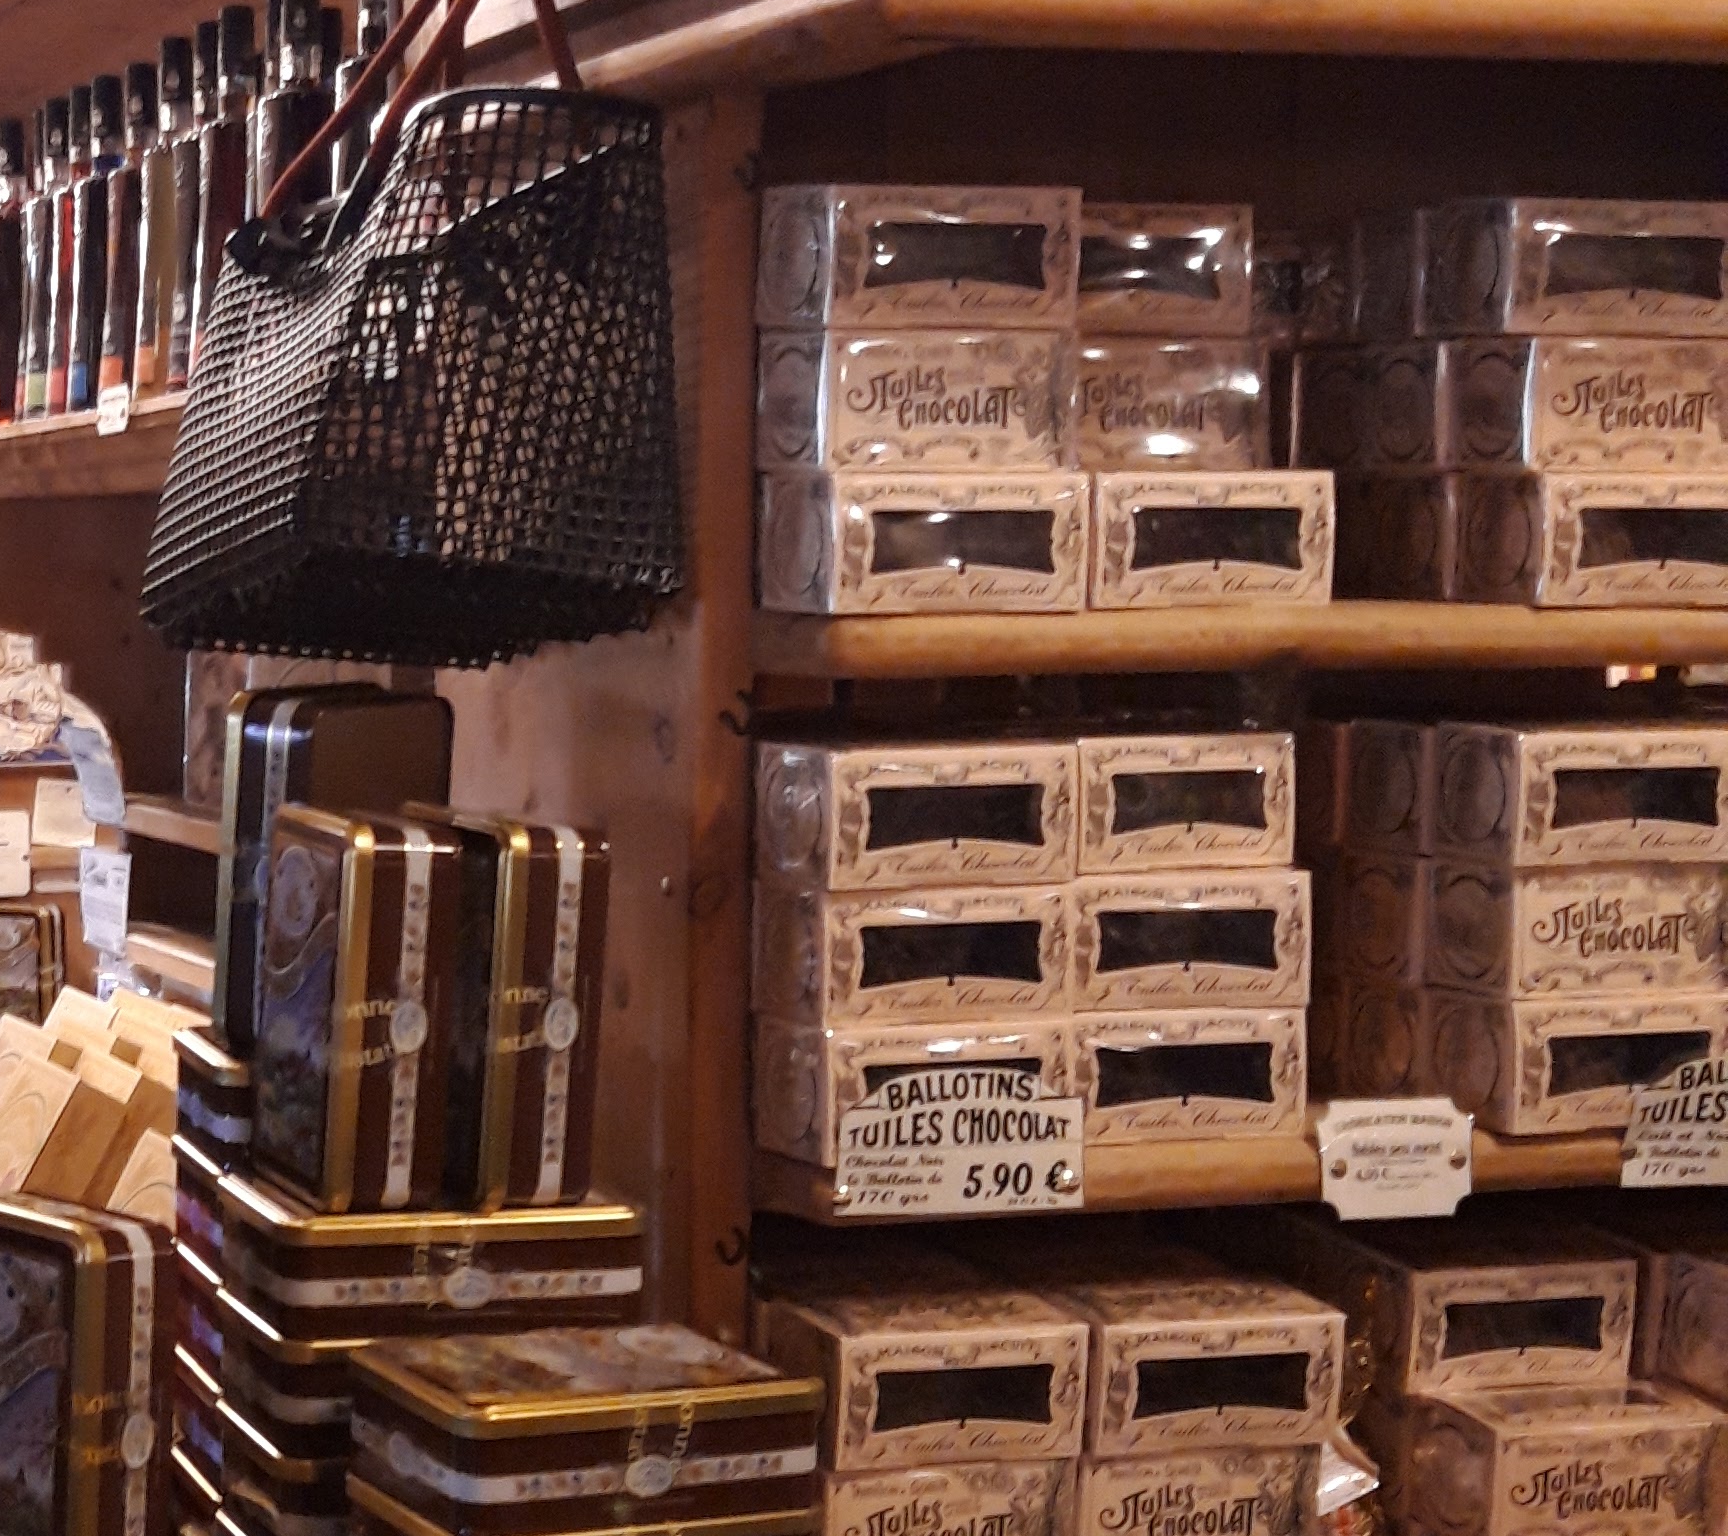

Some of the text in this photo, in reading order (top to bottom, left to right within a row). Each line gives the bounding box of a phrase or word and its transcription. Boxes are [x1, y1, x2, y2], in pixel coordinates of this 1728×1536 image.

[886, 1072, 1036, 1111] BALLOTINS
[1639, 1091, 1728, 1124] TUILES
[848, 1107, 1072, 1149] TUILES CHOCOLAT
[857, 1189, 892, 1205] 170
[962, 1161, 1034, 1200] 5,90
